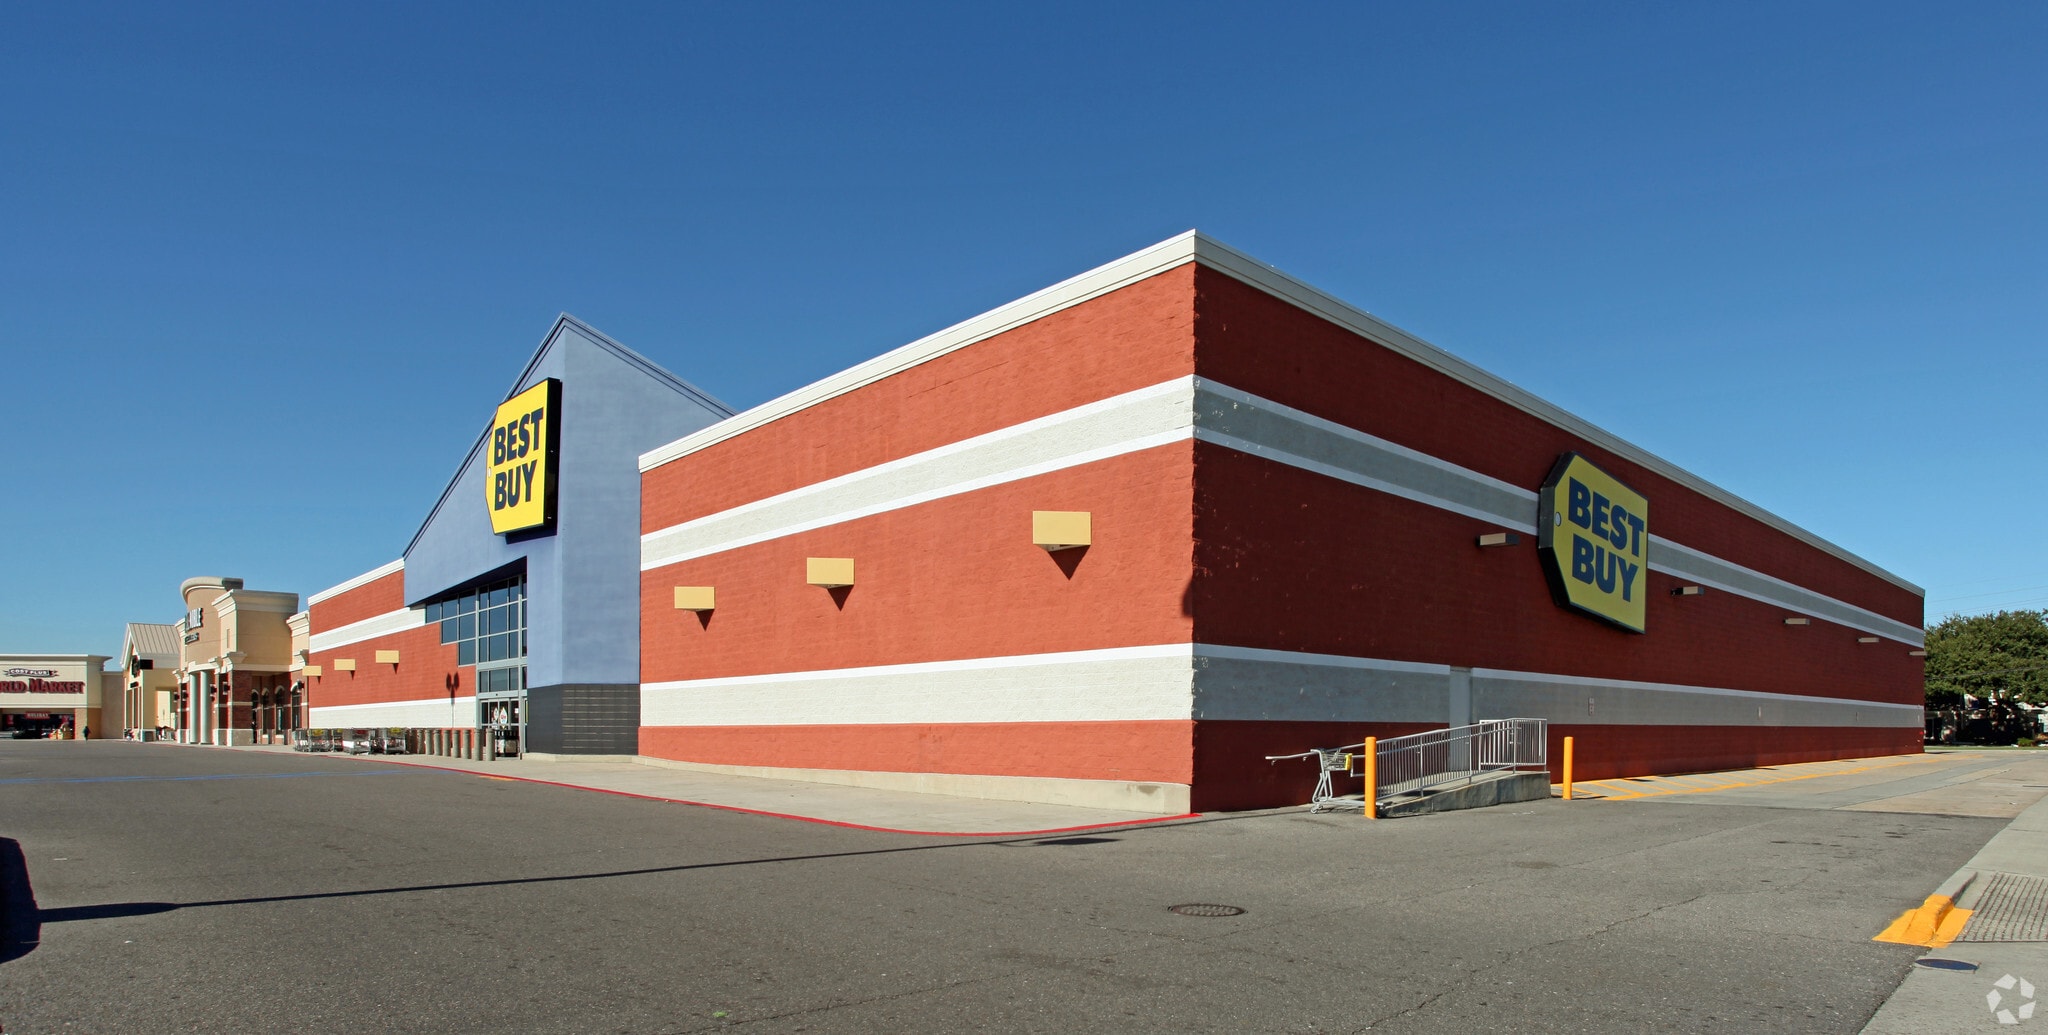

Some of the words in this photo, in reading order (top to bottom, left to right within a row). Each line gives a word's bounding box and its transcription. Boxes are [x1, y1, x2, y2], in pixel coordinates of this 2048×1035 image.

[494, 407, 544, 467] BEST
[494, 459, 538, 511] BUY
[1568, 475, 1645, 558] BEST
[1572, 532, 1639, 603] BUY
[28, 678, 86, 694] MARKET
